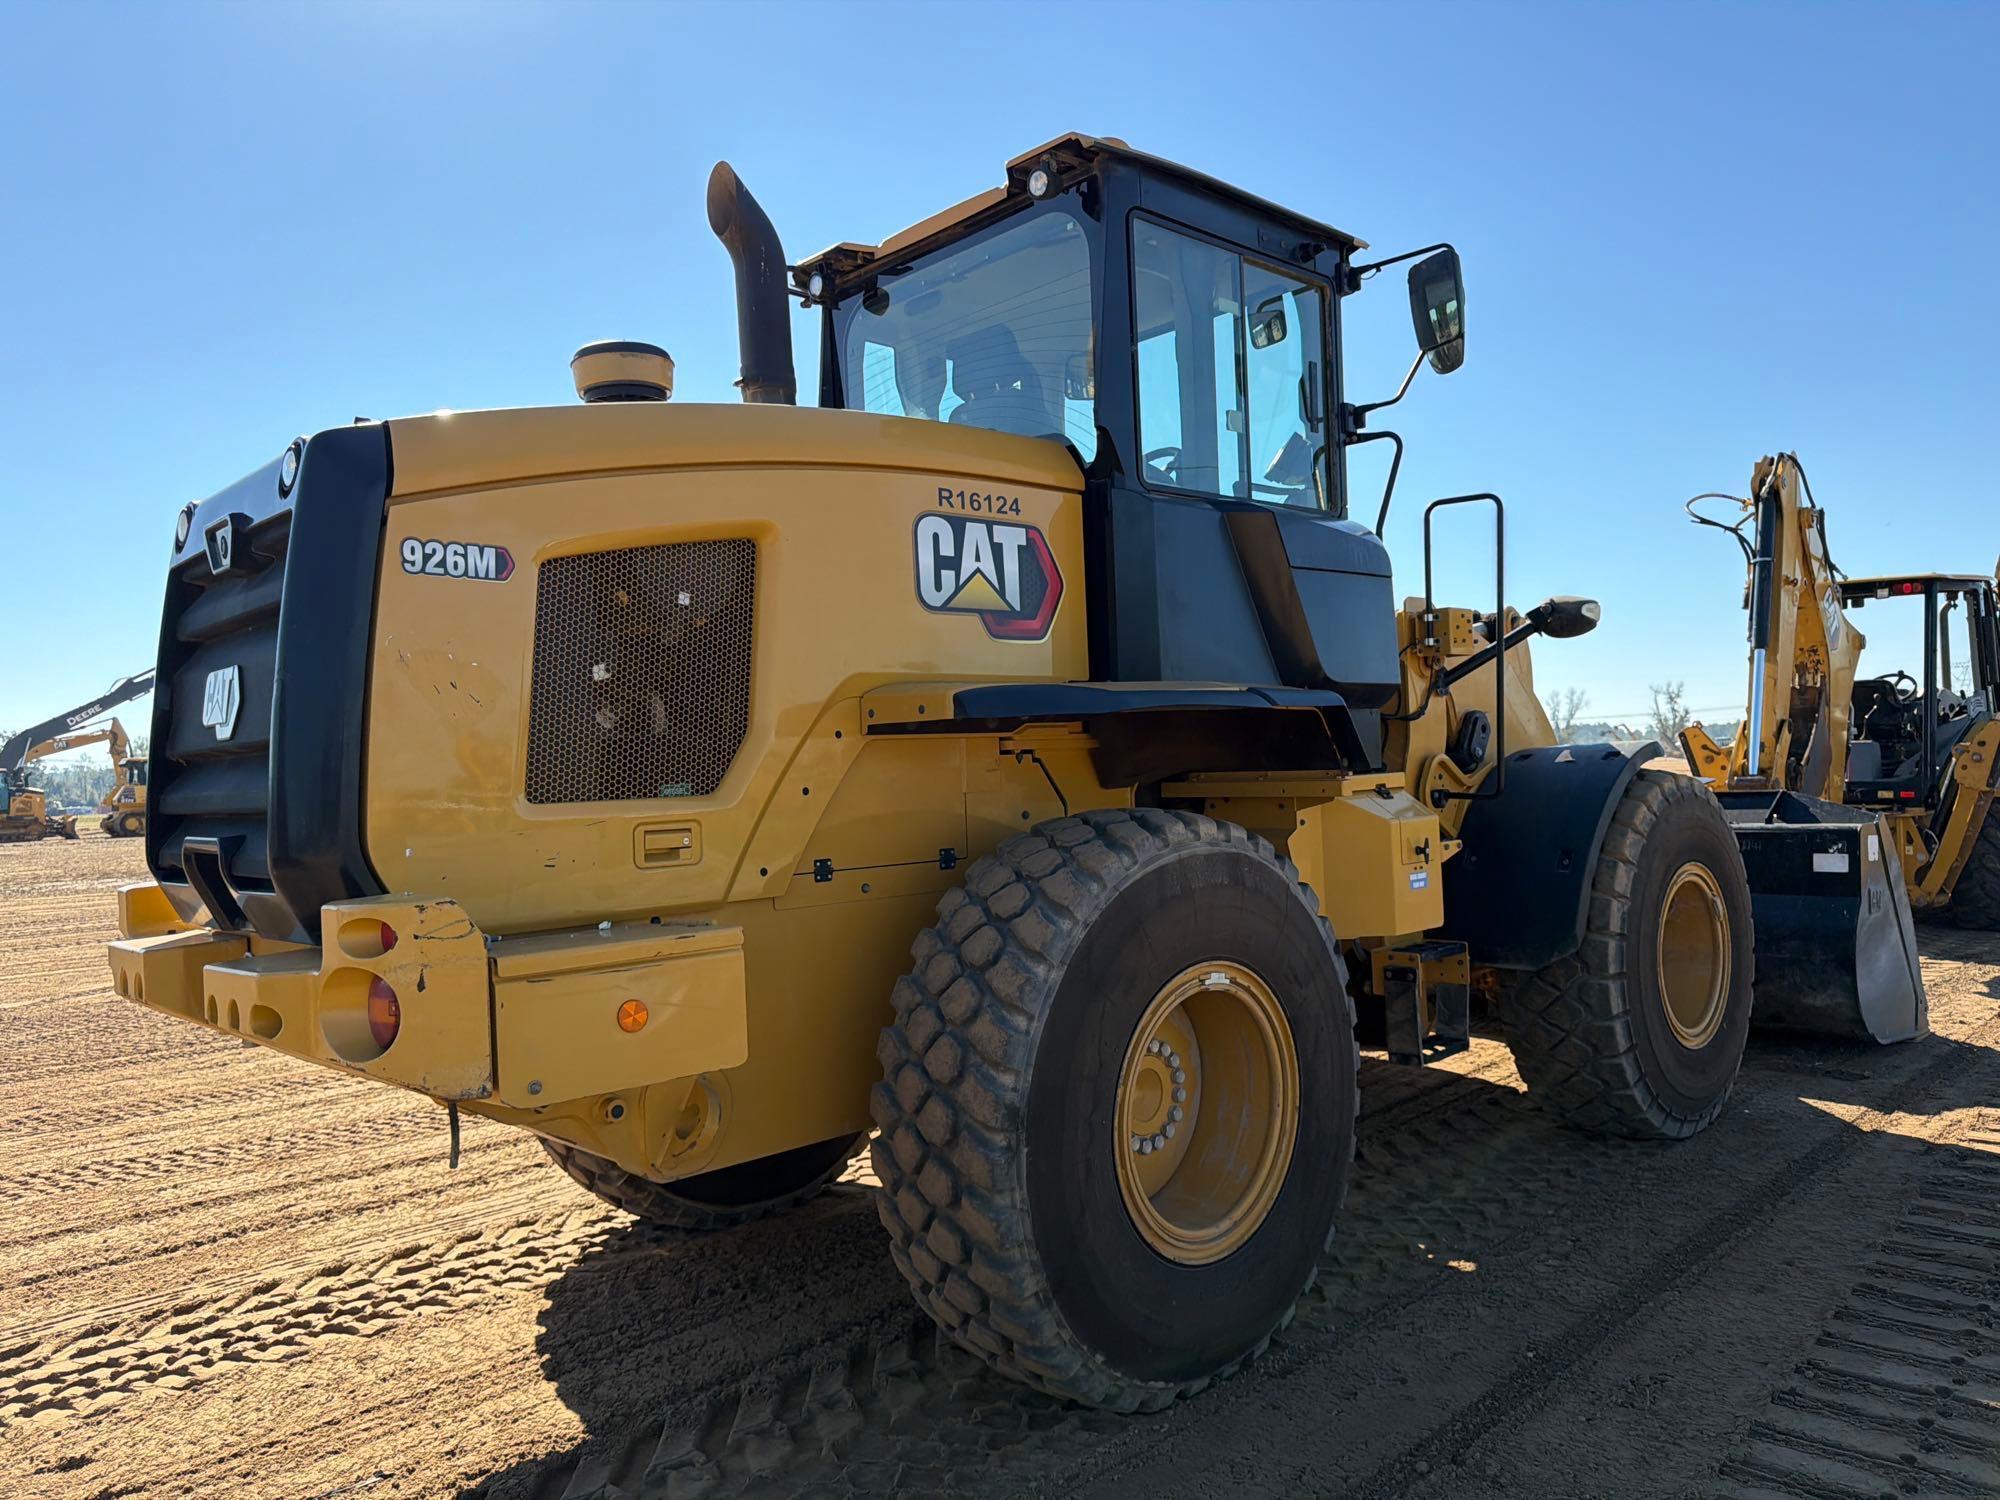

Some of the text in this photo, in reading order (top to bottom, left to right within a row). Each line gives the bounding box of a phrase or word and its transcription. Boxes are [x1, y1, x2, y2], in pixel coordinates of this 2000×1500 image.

[938, 487, 1021, 516] R16124
[402, 539, 496, 579] 926M
[917, 515, 1027, 612] CAT
[202, 666, 234, 728] CAT
[66, 703, 103, 726] DEERE
[53, 740, 67, 750] CAT
